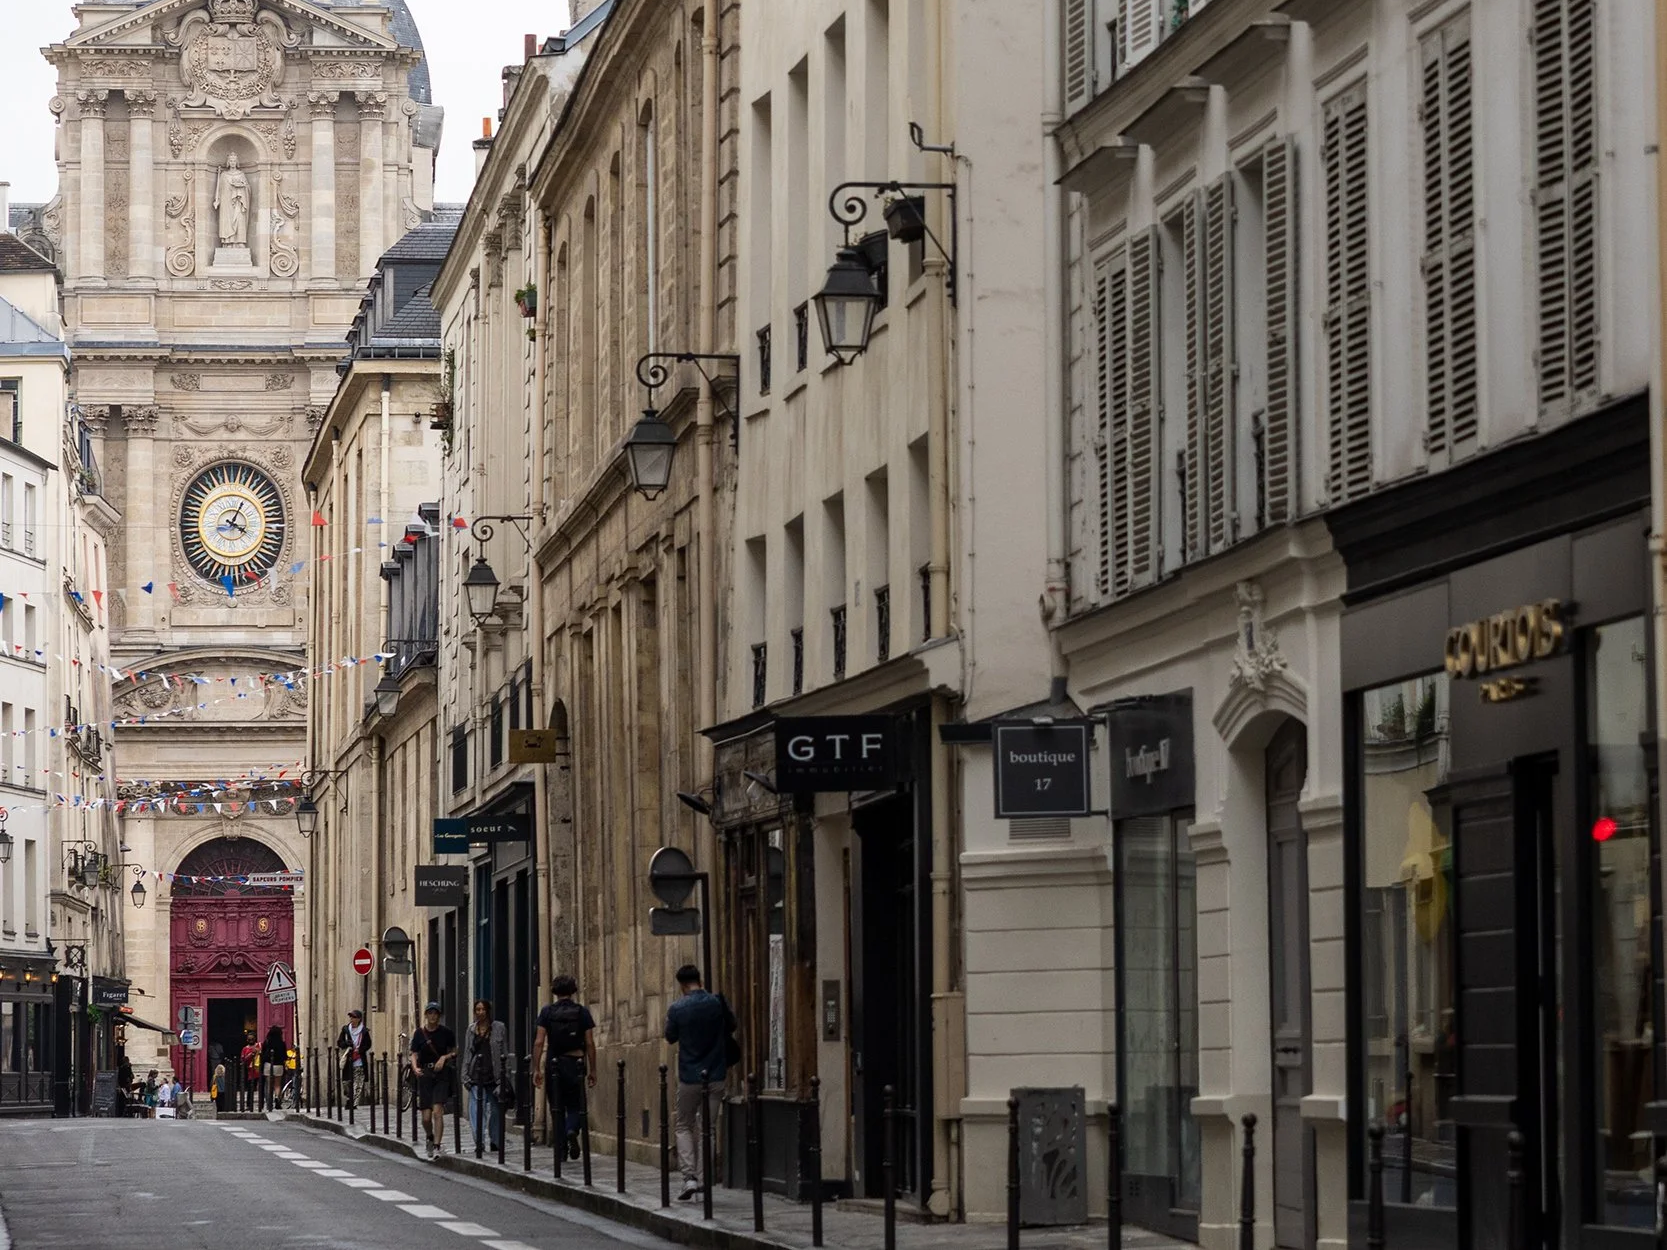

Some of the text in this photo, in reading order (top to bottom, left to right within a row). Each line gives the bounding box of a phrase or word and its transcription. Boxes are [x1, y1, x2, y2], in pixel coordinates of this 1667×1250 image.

[1445, 598, 1562, 678] COURTOIS
[787, 733, 883, 761] GTF
[1009, 750, 1076, 766] boutique
[1034, 778, 1052, 791] 17
